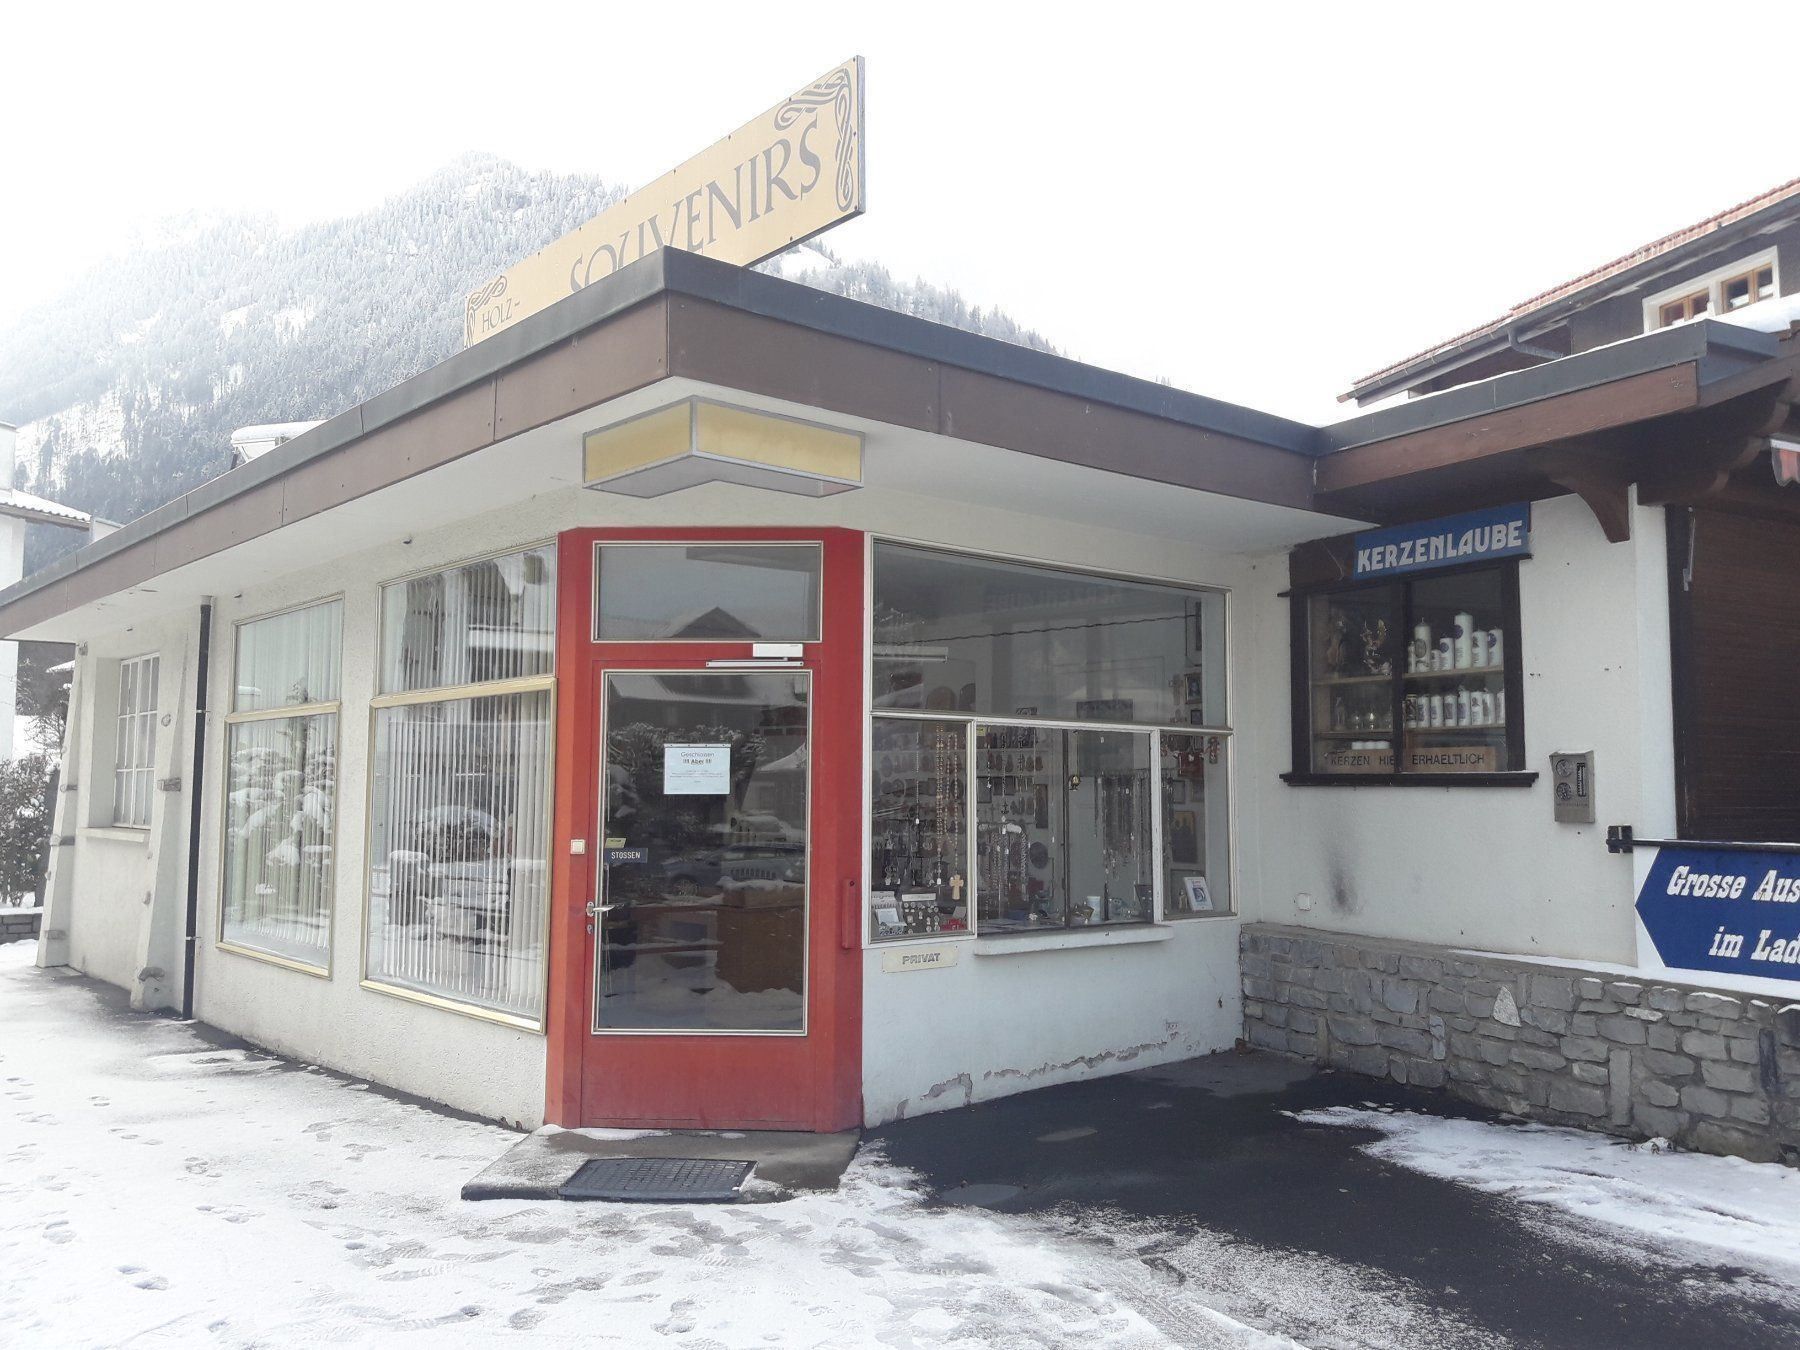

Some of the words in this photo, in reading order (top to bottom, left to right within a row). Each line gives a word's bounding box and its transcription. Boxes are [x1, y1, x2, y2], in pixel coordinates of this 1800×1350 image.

[1357, 520, 1523, 573] KERZENLAUBE
[1331, 755, 1370, 766] KERZEN
[1412, 753, 1485, 766] ERHAELTLICH
[611, 851, 641, 860] STOSSEN
[1666, 865, 1746, 900] Grosse
[1708, 925, 1744, 958] im
[1750, 929, 1800, 965] Lad
[901, 952, 941, 965] PRIVAT
